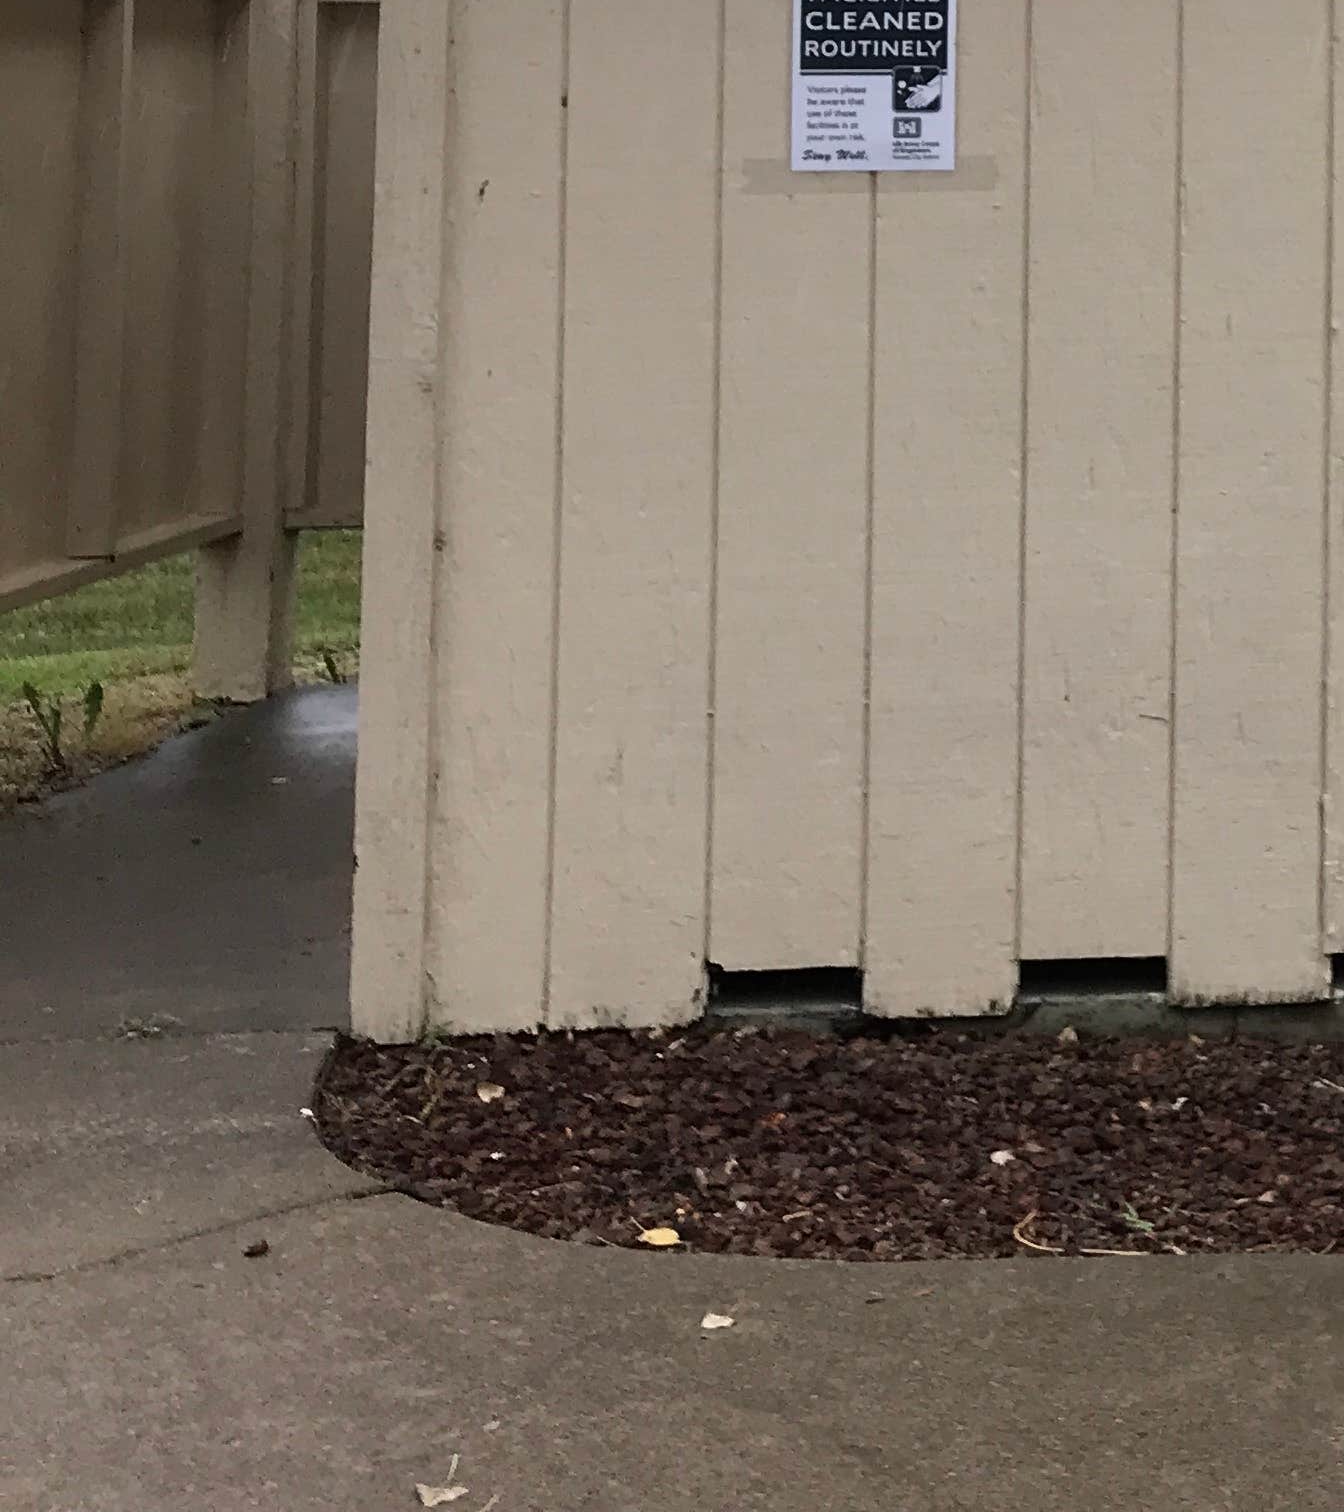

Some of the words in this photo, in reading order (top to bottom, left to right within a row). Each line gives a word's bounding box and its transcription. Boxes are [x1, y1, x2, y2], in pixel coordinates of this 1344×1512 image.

[805, 11, 944, 30] CLEANED
[804, 40, 942, 57] ROUTINELY
[802, 149, 831, 162] Stay
